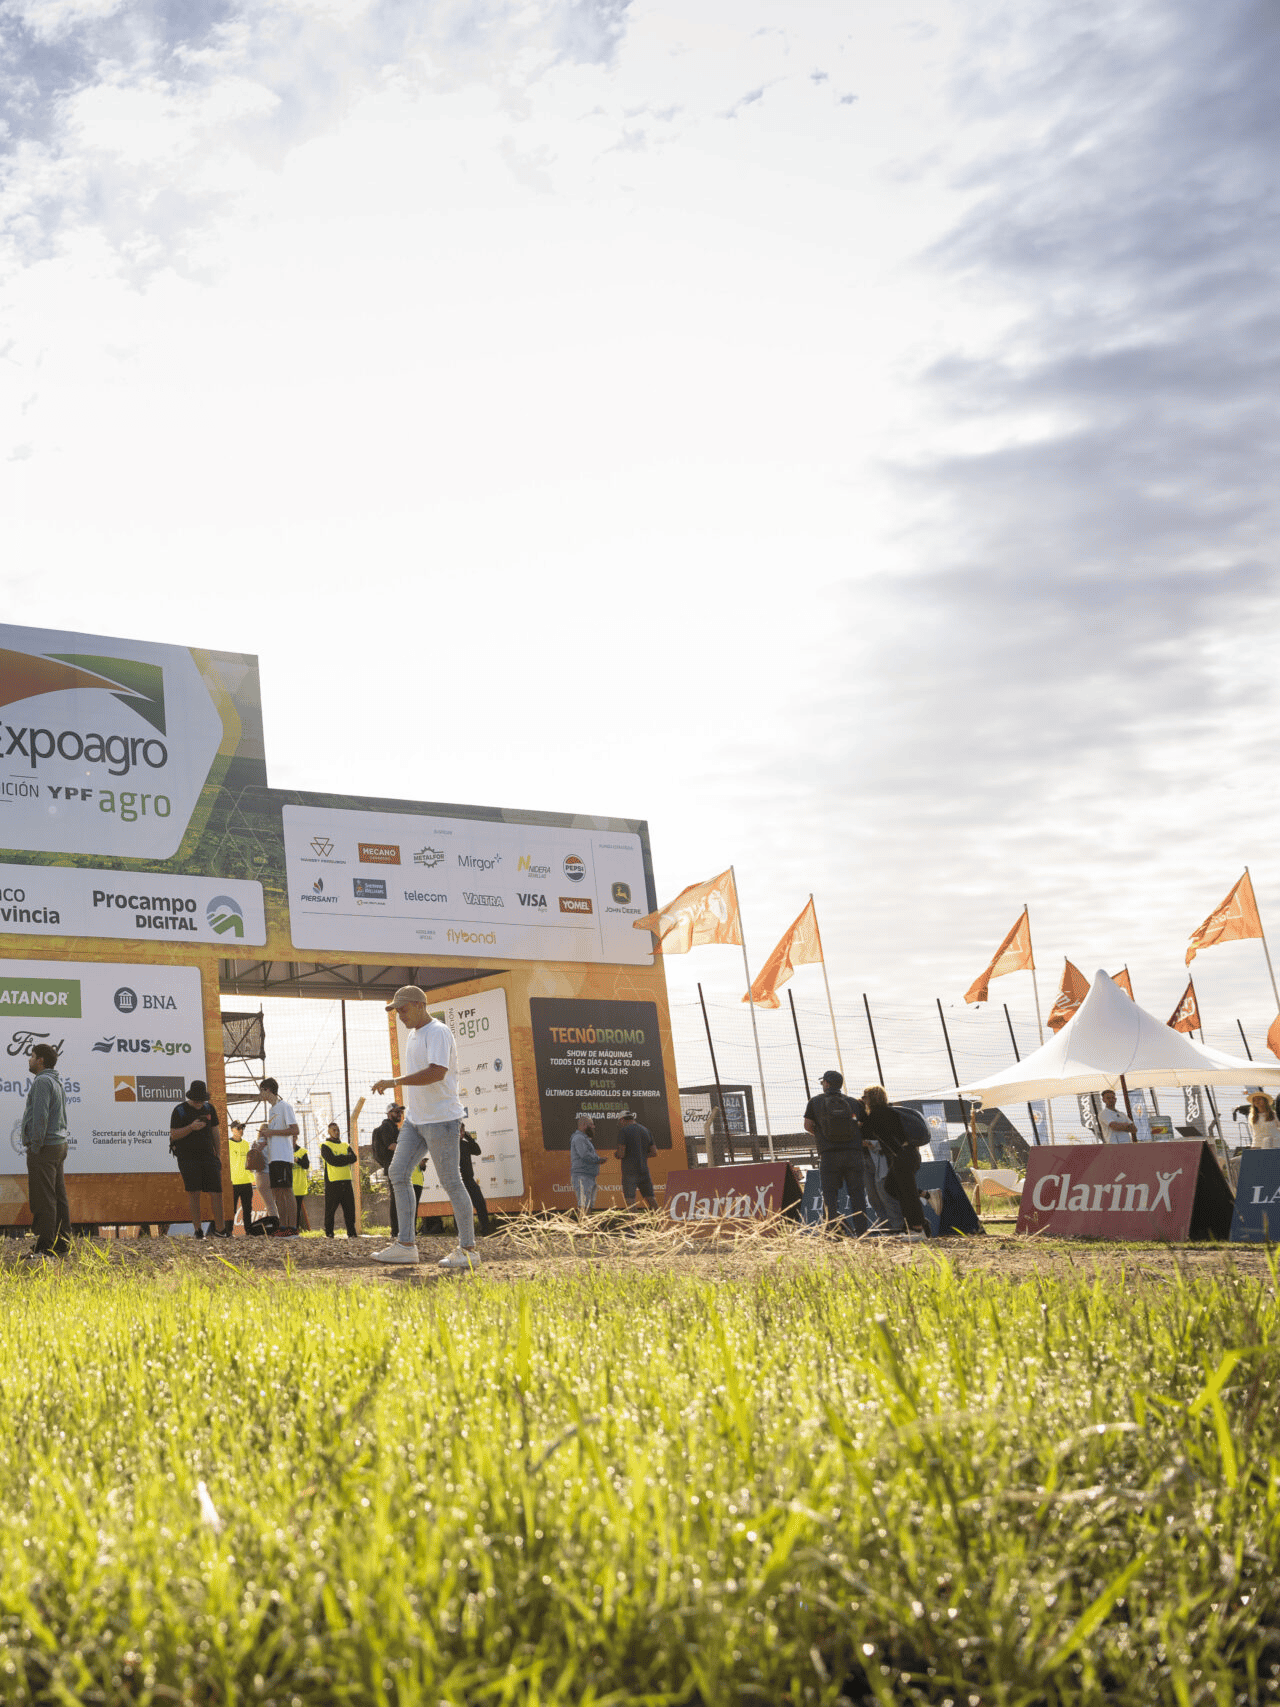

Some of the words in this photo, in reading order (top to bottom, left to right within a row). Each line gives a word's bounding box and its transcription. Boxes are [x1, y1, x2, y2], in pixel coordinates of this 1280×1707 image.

[47, 785, 93, 801] YPF
[98, 789, 171, 822] agro
[458, 854, 495, 871] Mirgor
[528, 865, 551, 874] NIDERA
[92, 890, 197, 917] Procampo
[300, 894, 338, 903] PIERSANTI
[404, 890, 448, 903] telecom
[462, 892, 504, 907] VALTRA
[516, 892, 548, 907] VISA
[562, 900, 590, 911] YOMEL
[135, 914, 198, 931] DIGITAL
[446, 928, 496, 945] flybondi
[141, 995, 178, 1010] BNA
[457, 1008, 476, 1019] YPF
[459, 1017, 490, 1038] agro
[549, 1024, 645, 1044] TECNÓDROMO
[7, 1031, 64, 1056] Fod
[598, 1049, 633, 1058] MÁQUINAS
[550, 1058, 572, 1066] TODOS
[573, 1058, 586, 1066] LOS
[587, 1057, 602, 1066] DÍAS
[609, 1059, 622, 1067] LAS
[623, 1059, 640, 1067] 10.00
[619, 1067, 629, 1075] HS
[590, 1080, 616, 1088] PLOTS
[138, 1085, 182, 1100] Ternium
[545, 1088, 574, 1097] ÚLTIMOS
[575, 1089, 621, 1097] DESARROLLOS
[622, 1089, 631, 1097] EN
[683, 1108, 711, 1122] Ford
[92, 1129, 125, 1137] Secretaría
[137, 1130, 171, 1139] Agricultur
[92, 1137, 125, 1145] Ganadería
[1033, 1172, 1151, 1213] Clarín
[670, 1187, 751, 1221] Clarín
